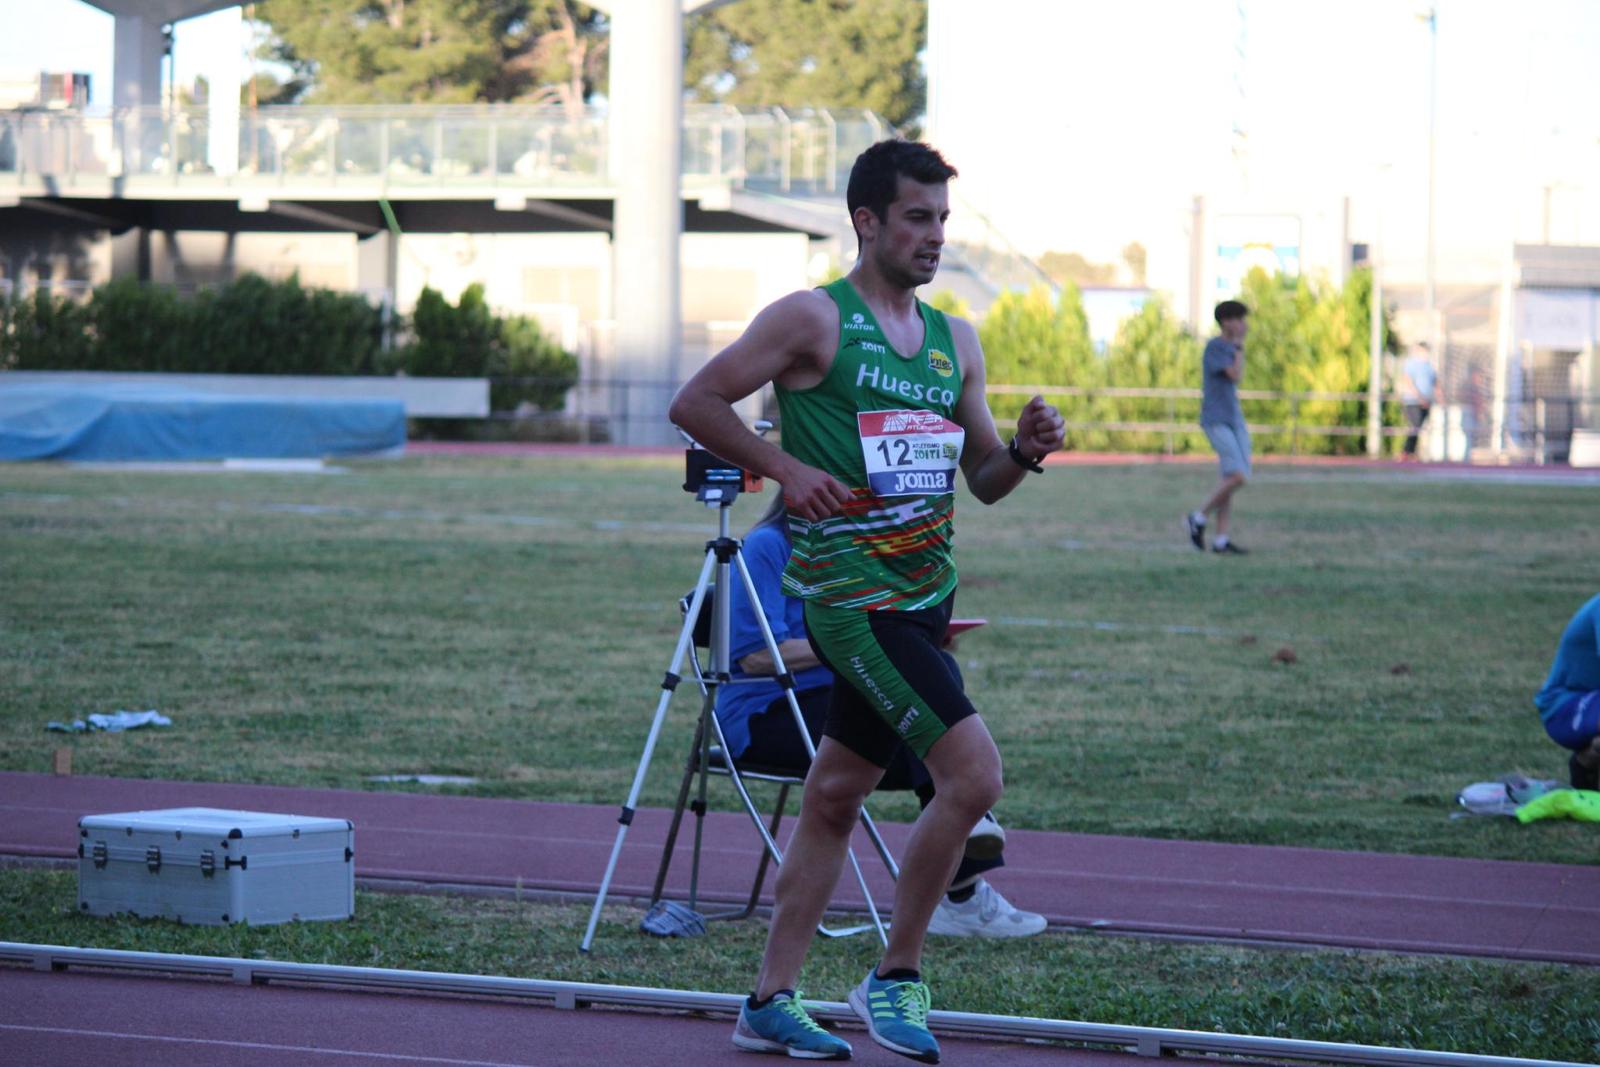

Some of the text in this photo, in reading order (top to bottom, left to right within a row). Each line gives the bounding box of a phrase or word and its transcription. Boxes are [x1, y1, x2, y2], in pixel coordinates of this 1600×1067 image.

[844, 322, 875, 331] VIATOR
[856, 363, 954, 409] Huesca
[877, 439, 913, 467] 12
[895, 472, 948, 492] Joma
[850, 656, 895, 711] Huesca
